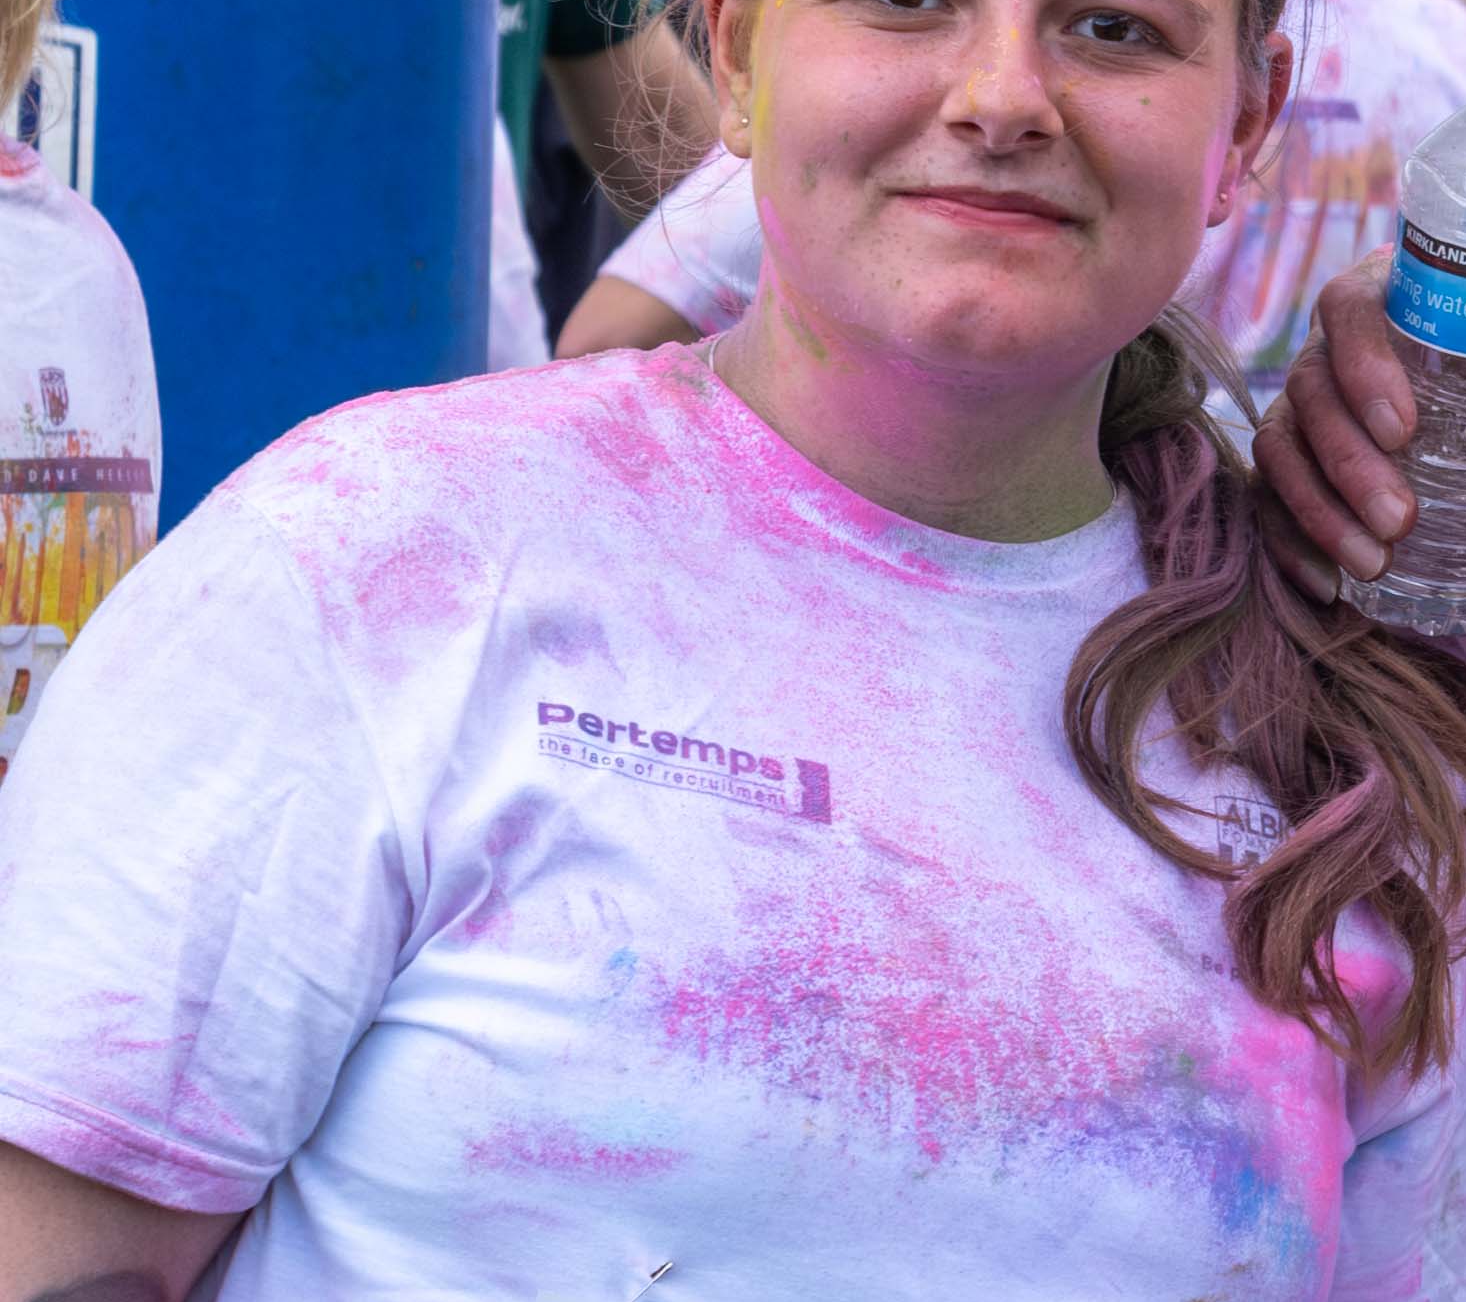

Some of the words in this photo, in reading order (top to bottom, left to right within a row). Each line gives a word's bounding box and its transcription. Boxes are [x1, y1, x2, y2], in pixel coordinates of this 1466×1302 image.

[1404, 308, 1423, 329] 500
[1423, 321, 1438, 336] mL
[537, 701, 785, 781] Pertemps
[538, 737, 570, 755] the
[581, 746, 625, 768] face
[634, 763, 653, 776] of
[663, 768, 786, 805] recruitment
